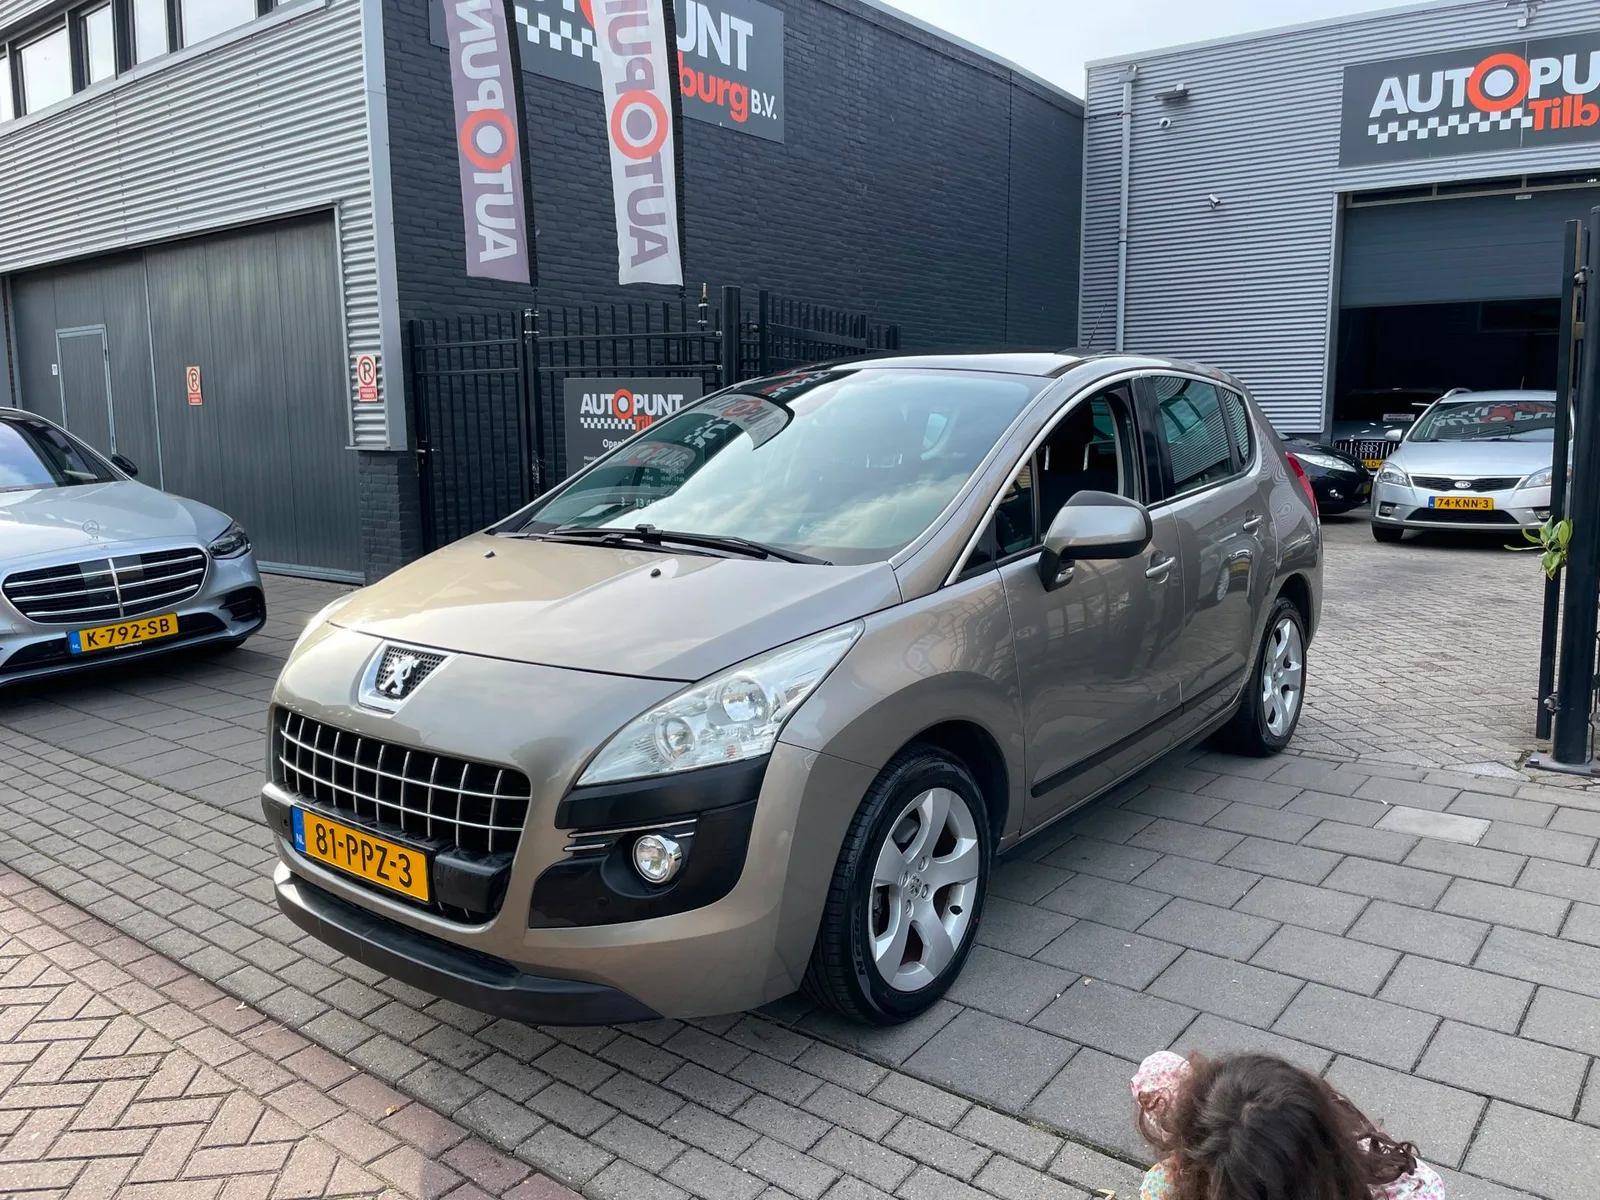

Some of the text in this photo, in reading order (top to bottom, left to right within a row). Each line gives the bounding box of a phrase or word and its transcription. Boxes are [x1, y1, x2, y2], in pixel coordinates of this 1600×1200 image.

[673, 0, 753, 71] UNT
[677, 50, 777, 123] burg B.V.
[1369, 53, 1600, 118] AUTOPU
[1528, 95, 1600, 131] Tilb
[580, 388, 683, 420] AUTOPUNT
[1437, 498, 1489, 509] 74-KNN-3
[87, 618, 171, 647] K-792-SB
[315, 823, 412, 889] 81-PPZ-3
